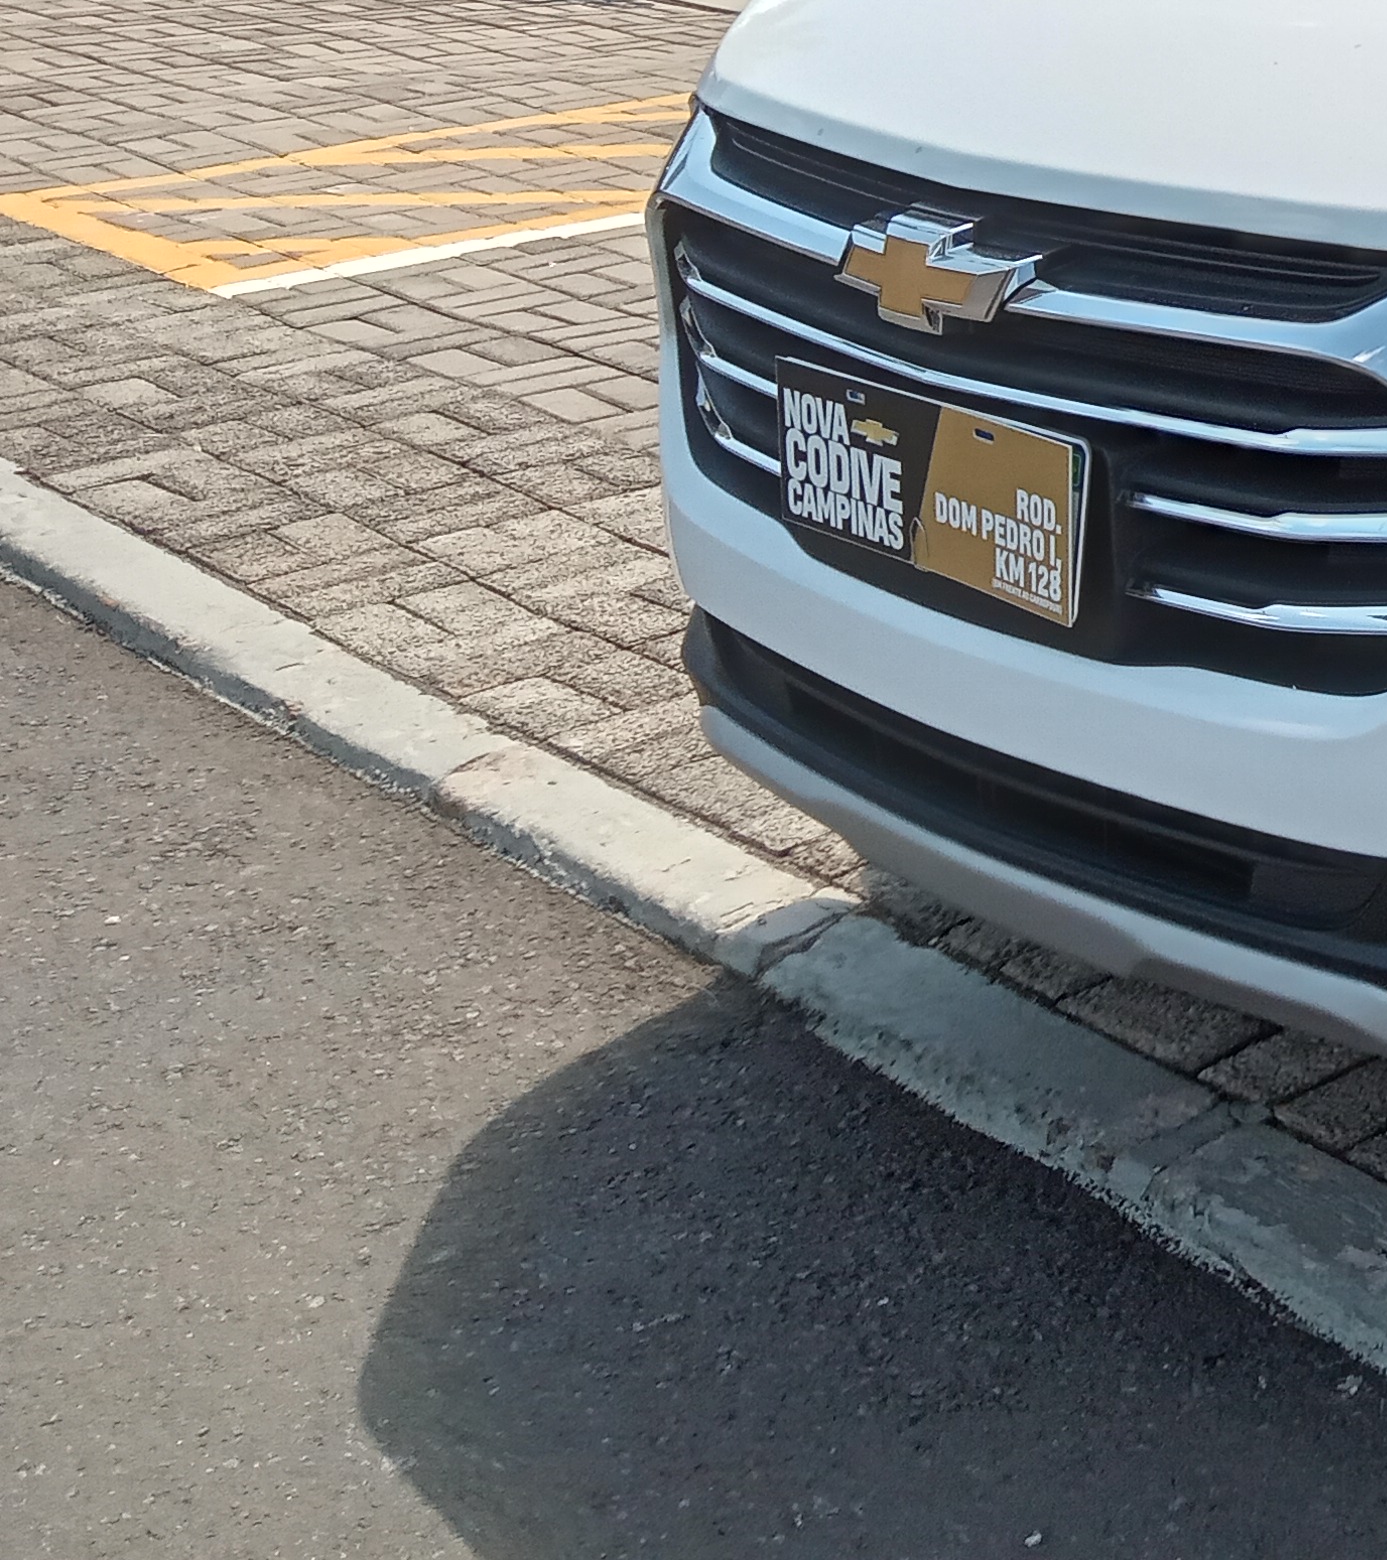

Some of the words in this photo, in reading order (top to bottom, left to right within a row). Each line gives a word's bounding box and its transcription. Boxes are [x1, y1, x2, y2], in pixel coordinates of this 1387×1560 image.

[783, 387, 851, 446] NOVA
[785, 427, 904, 515] CODIVE
[788, 478, 905, 550] CAMPINAS
[934, 491, 978, 537] DOM
[981, 508, 1046, 562] PEDRO
[1016, 488, 1062, 535] ROD.
[995, 547, 1025, 588] KM
[1028, 561, 1062, 602] 128
